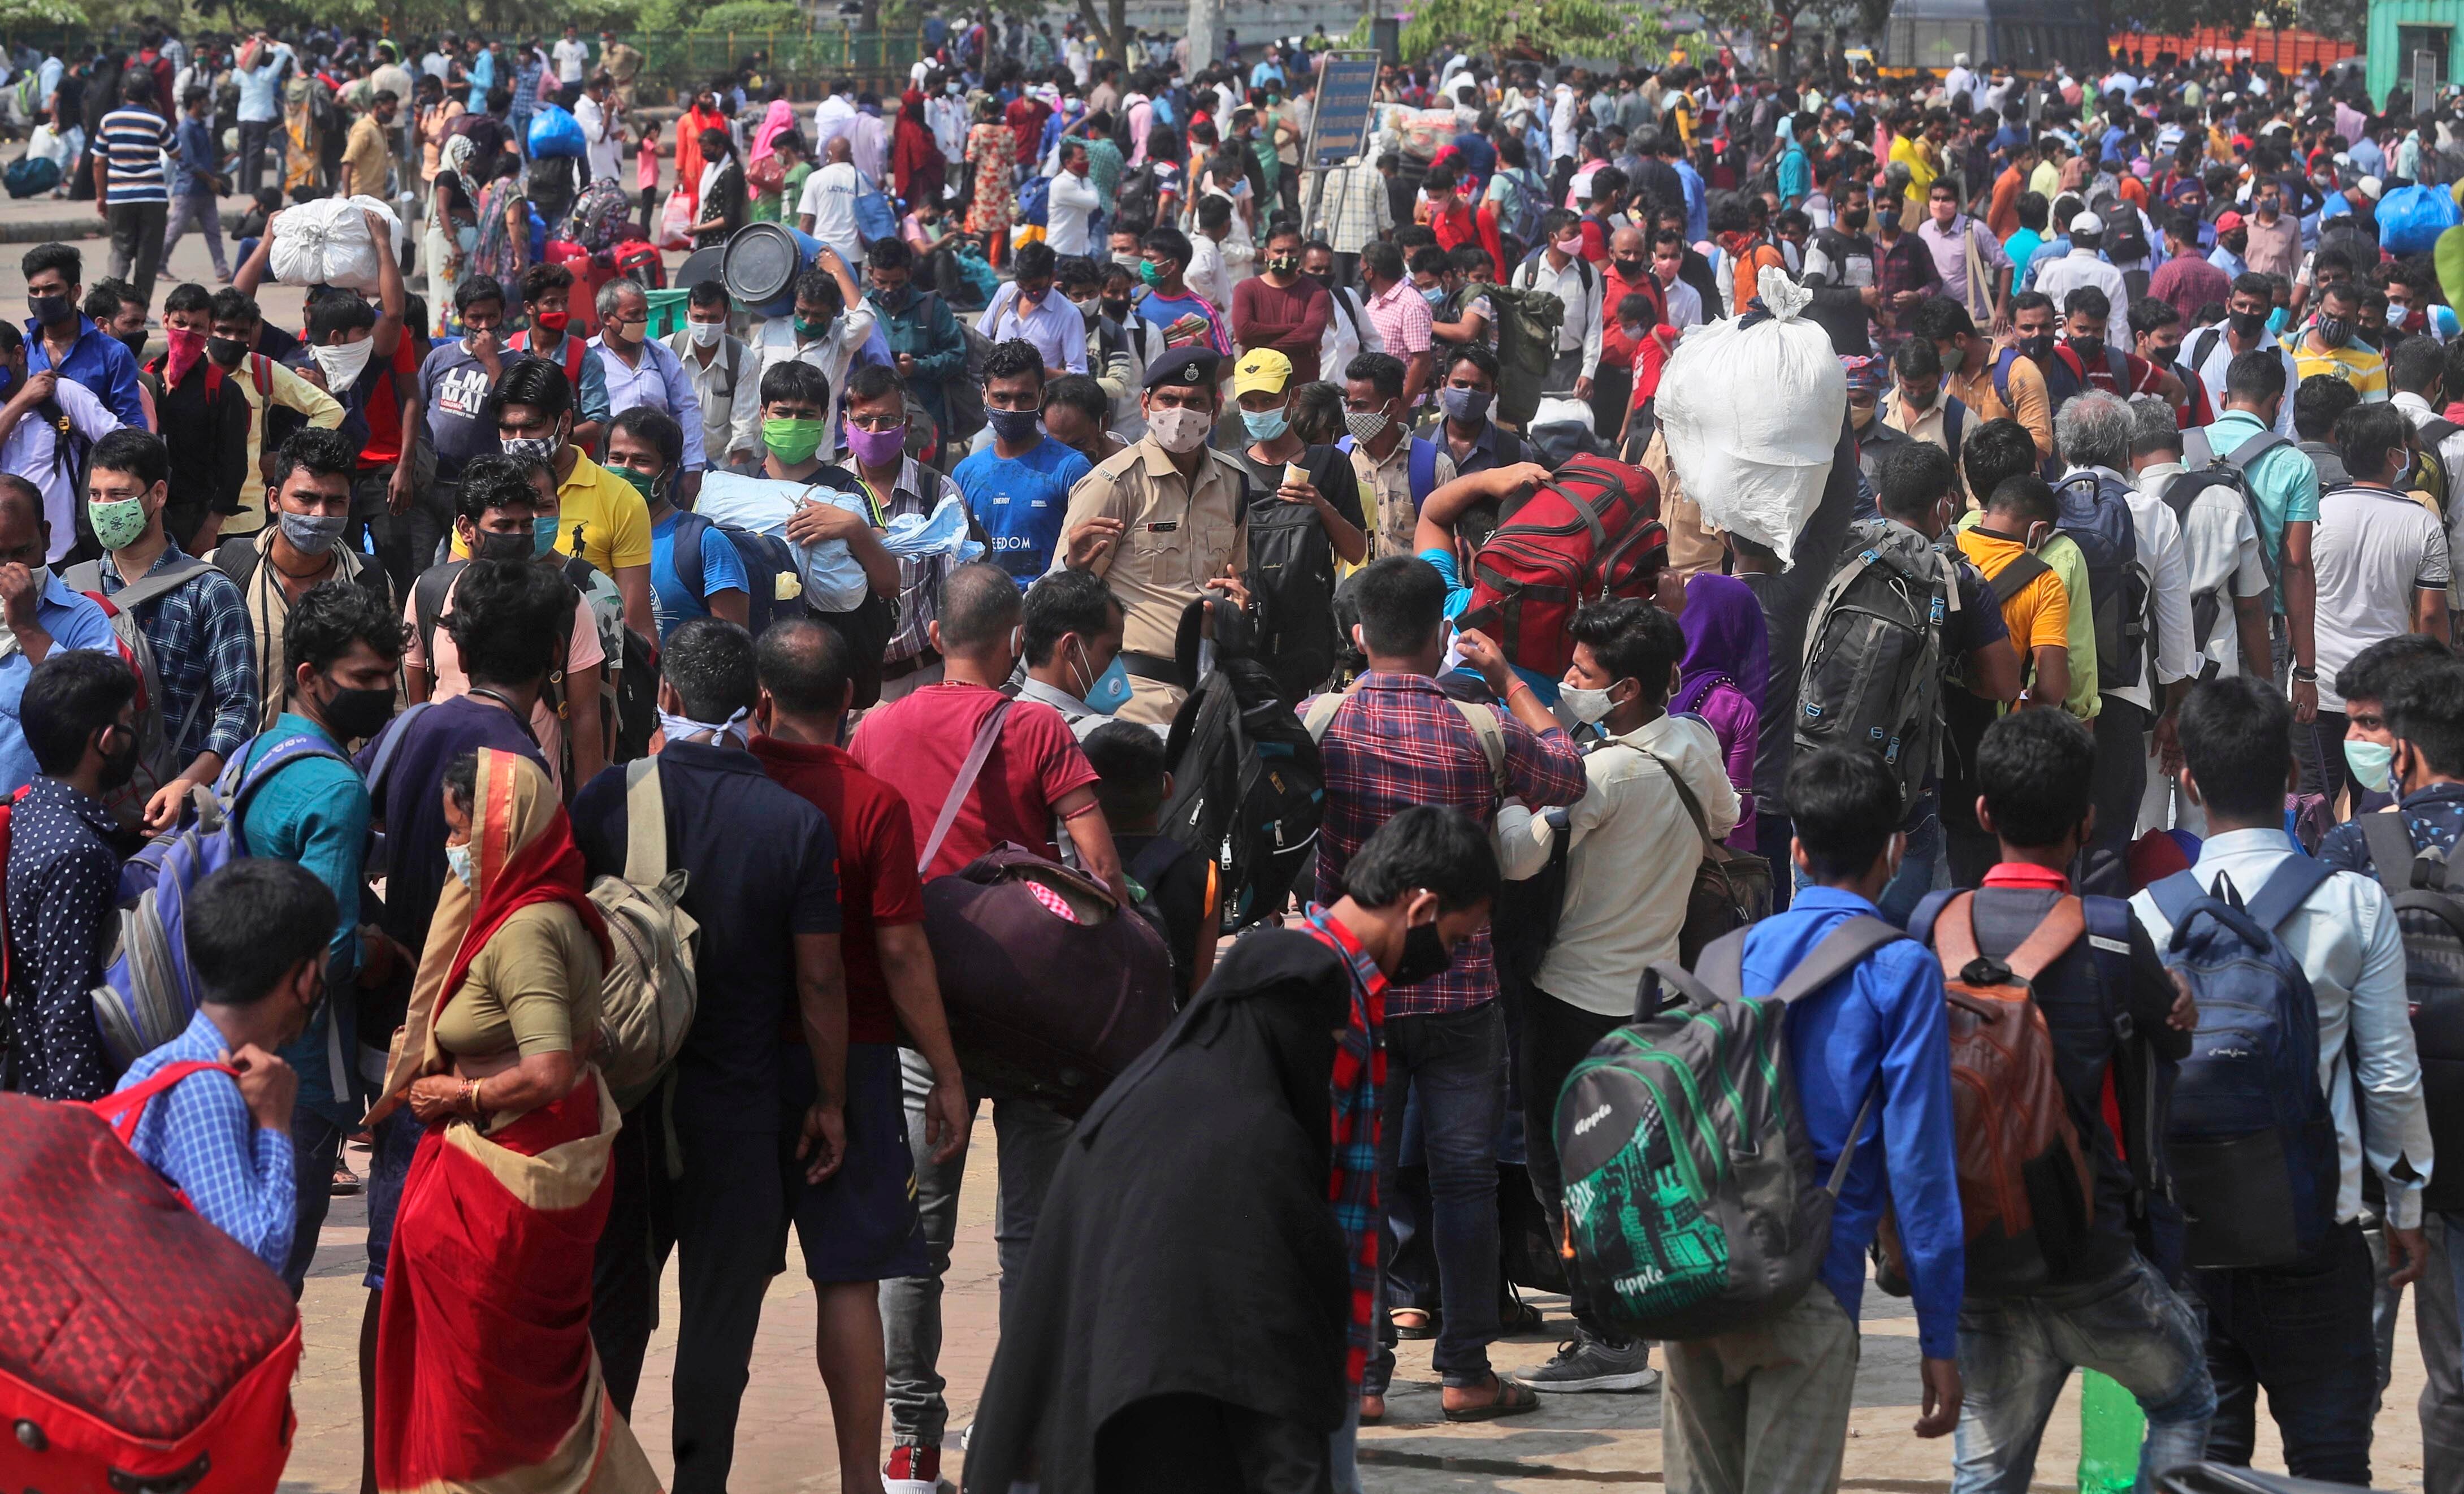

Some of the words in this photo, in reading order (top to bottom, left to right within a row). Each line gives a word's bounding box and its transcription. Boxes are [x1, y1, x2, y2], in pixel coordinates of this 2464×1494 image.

[445, 367, 489, 392] LM
[441, 386, 483, 414] MAI
[991, 536, 1030, 550] EEDOM
[1613, 1264, 1666, 1297] apple
